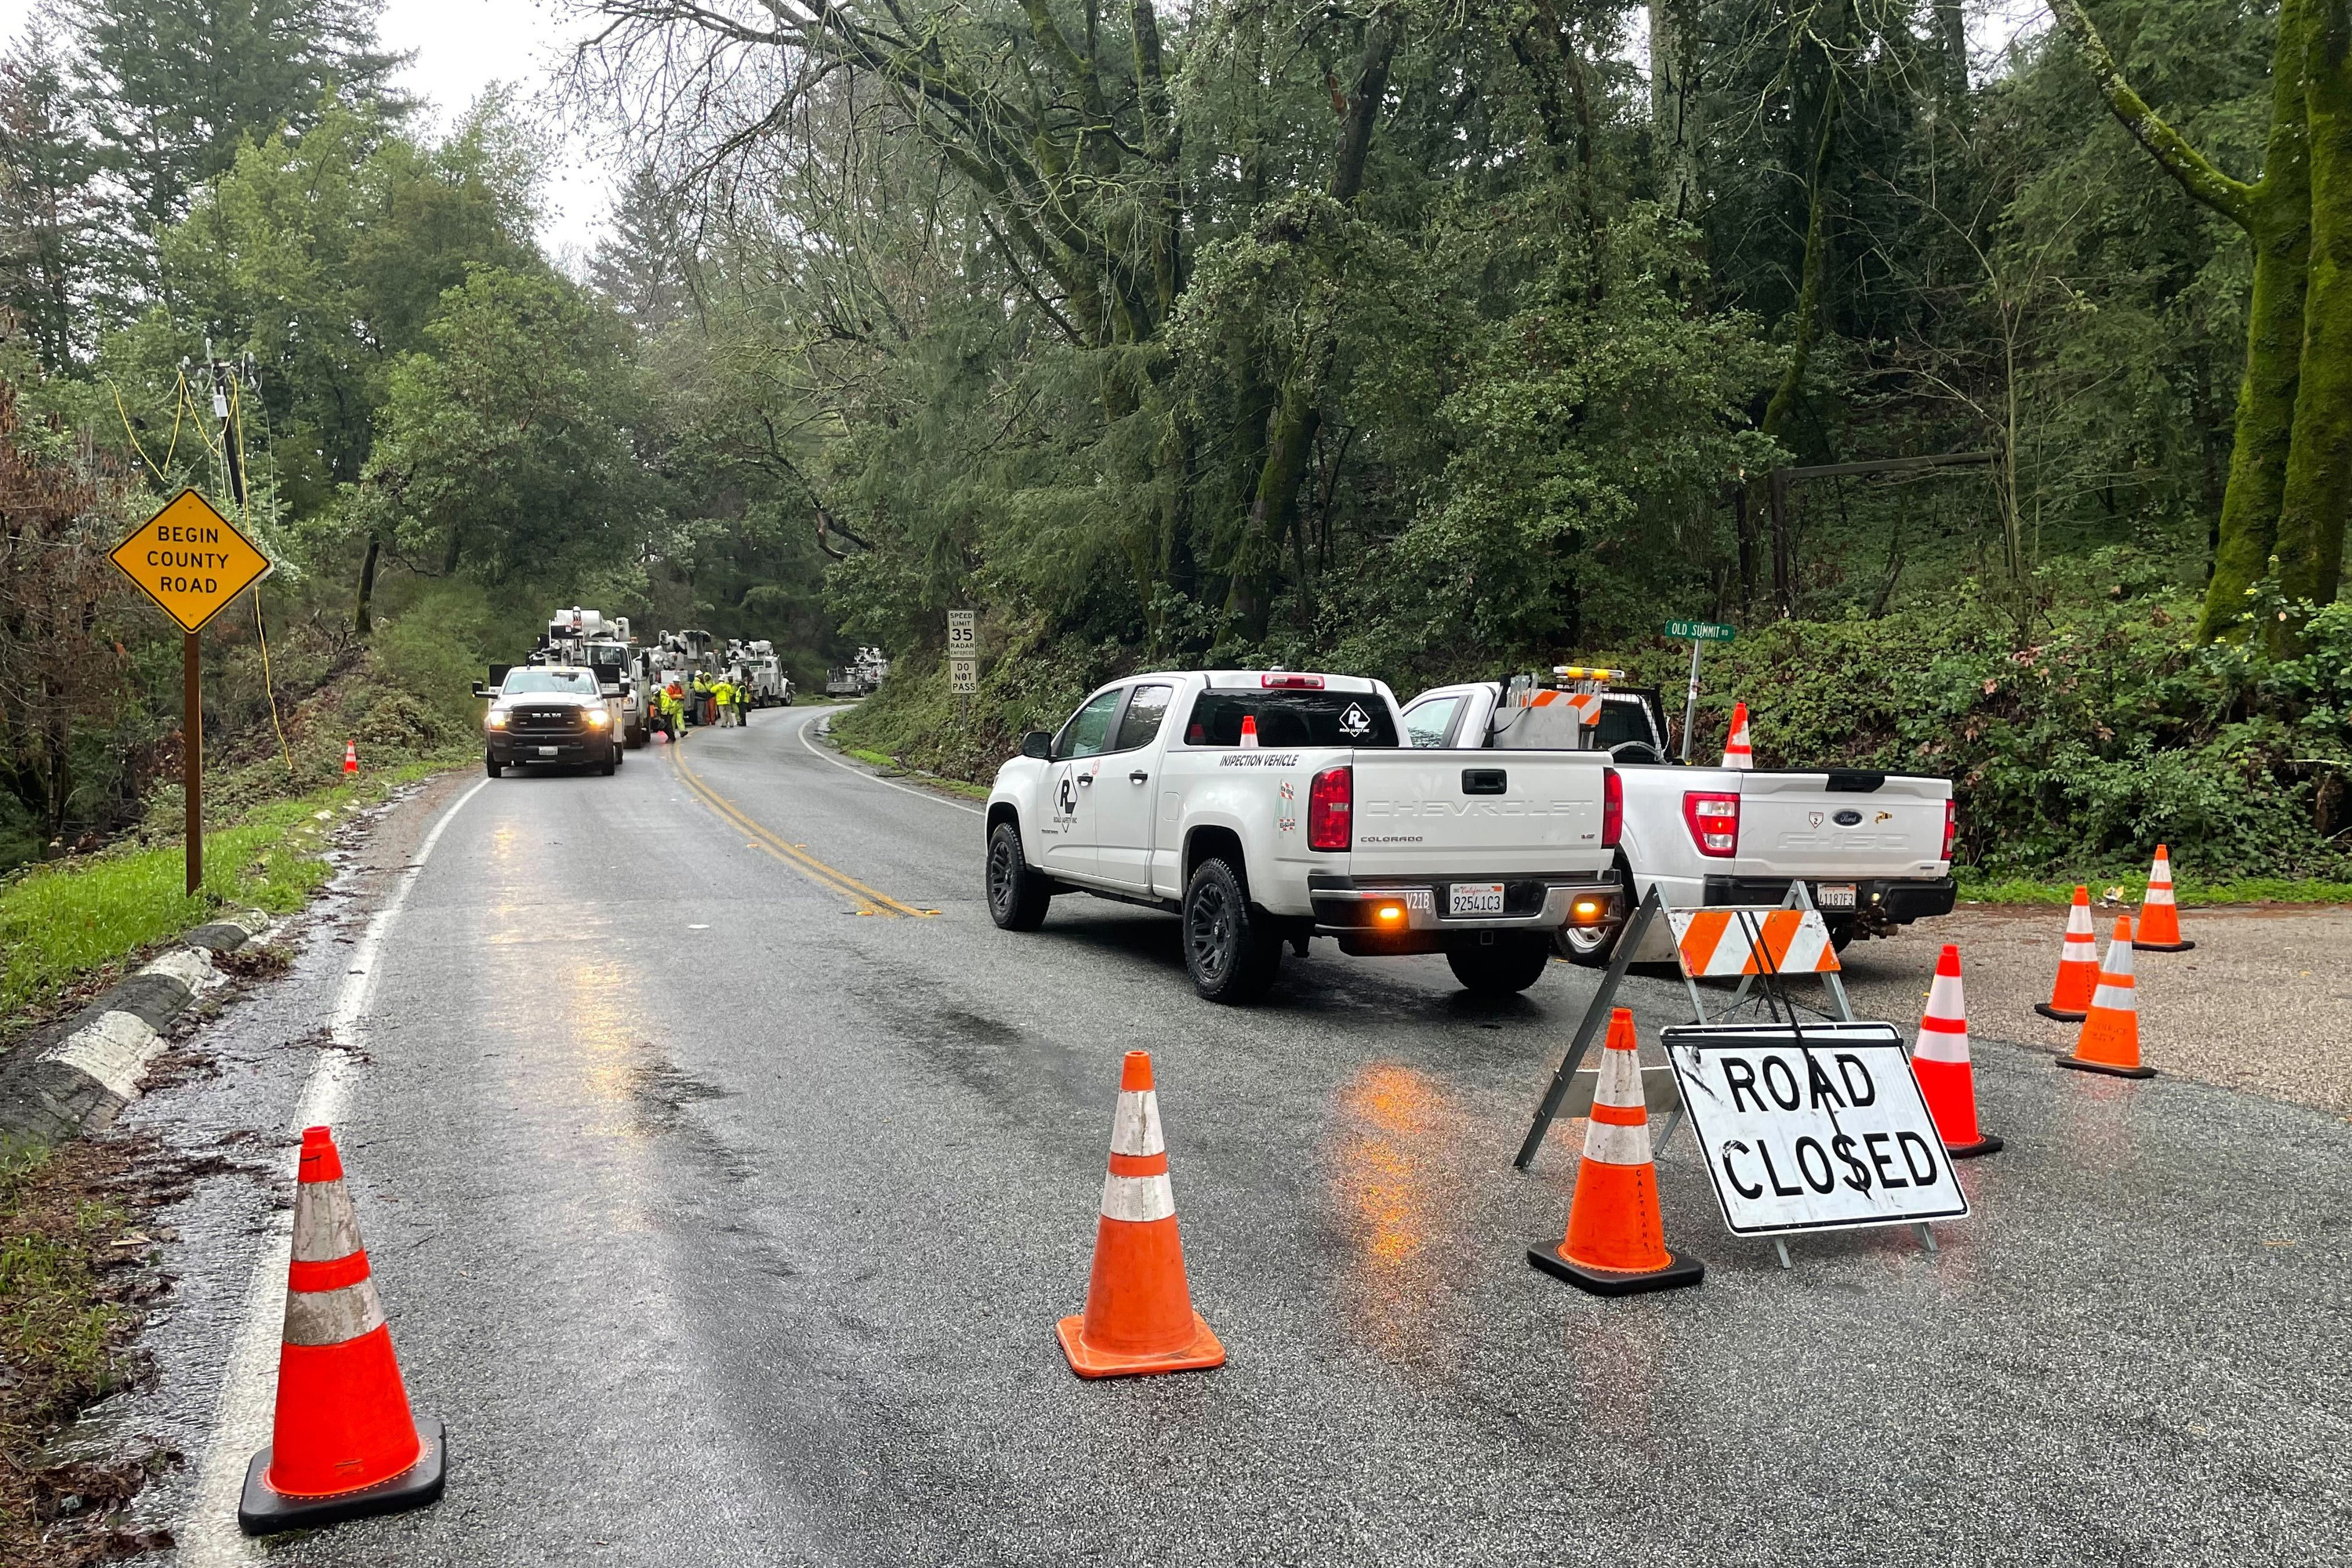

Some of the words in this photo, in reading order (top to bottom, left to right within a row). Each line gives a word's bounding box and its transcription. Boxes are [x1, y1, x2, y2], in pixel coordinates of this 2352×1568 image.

[158, 526, 219, 543] BEGIN
[147, 551, 229, 568] COUNTY
[160, 576, 217, 593] ROAD
[952, 629, 973, 641] 35
[1671, 622, 1687, 635] OLD
[1691, 624, 1720, 638] SUMMIT
[957, 662, 969, 671] DO
[1219, 754, 1264, 767] INSPECTION
[1264, 754, 1300, 767] VEHICLE
[1366, 800, 1594, 817] CHEVROLET
[1840, 812, 1857, 822] Ford
[1777, 832, 1911, 850] F-150
[1461, 886, 1494, 895] California
[1406, 892, 1430, 909] V21B
[1454, 895, 1501, 911] 92541C3
[1819, 893, 1853, 906] 41187F3
[1719, 1054, 1876, 1113] ROAD
[1722, 1131, 1938, 1200] CLOSED
[1635, 1169, 1649, 1250] CALTRANS
